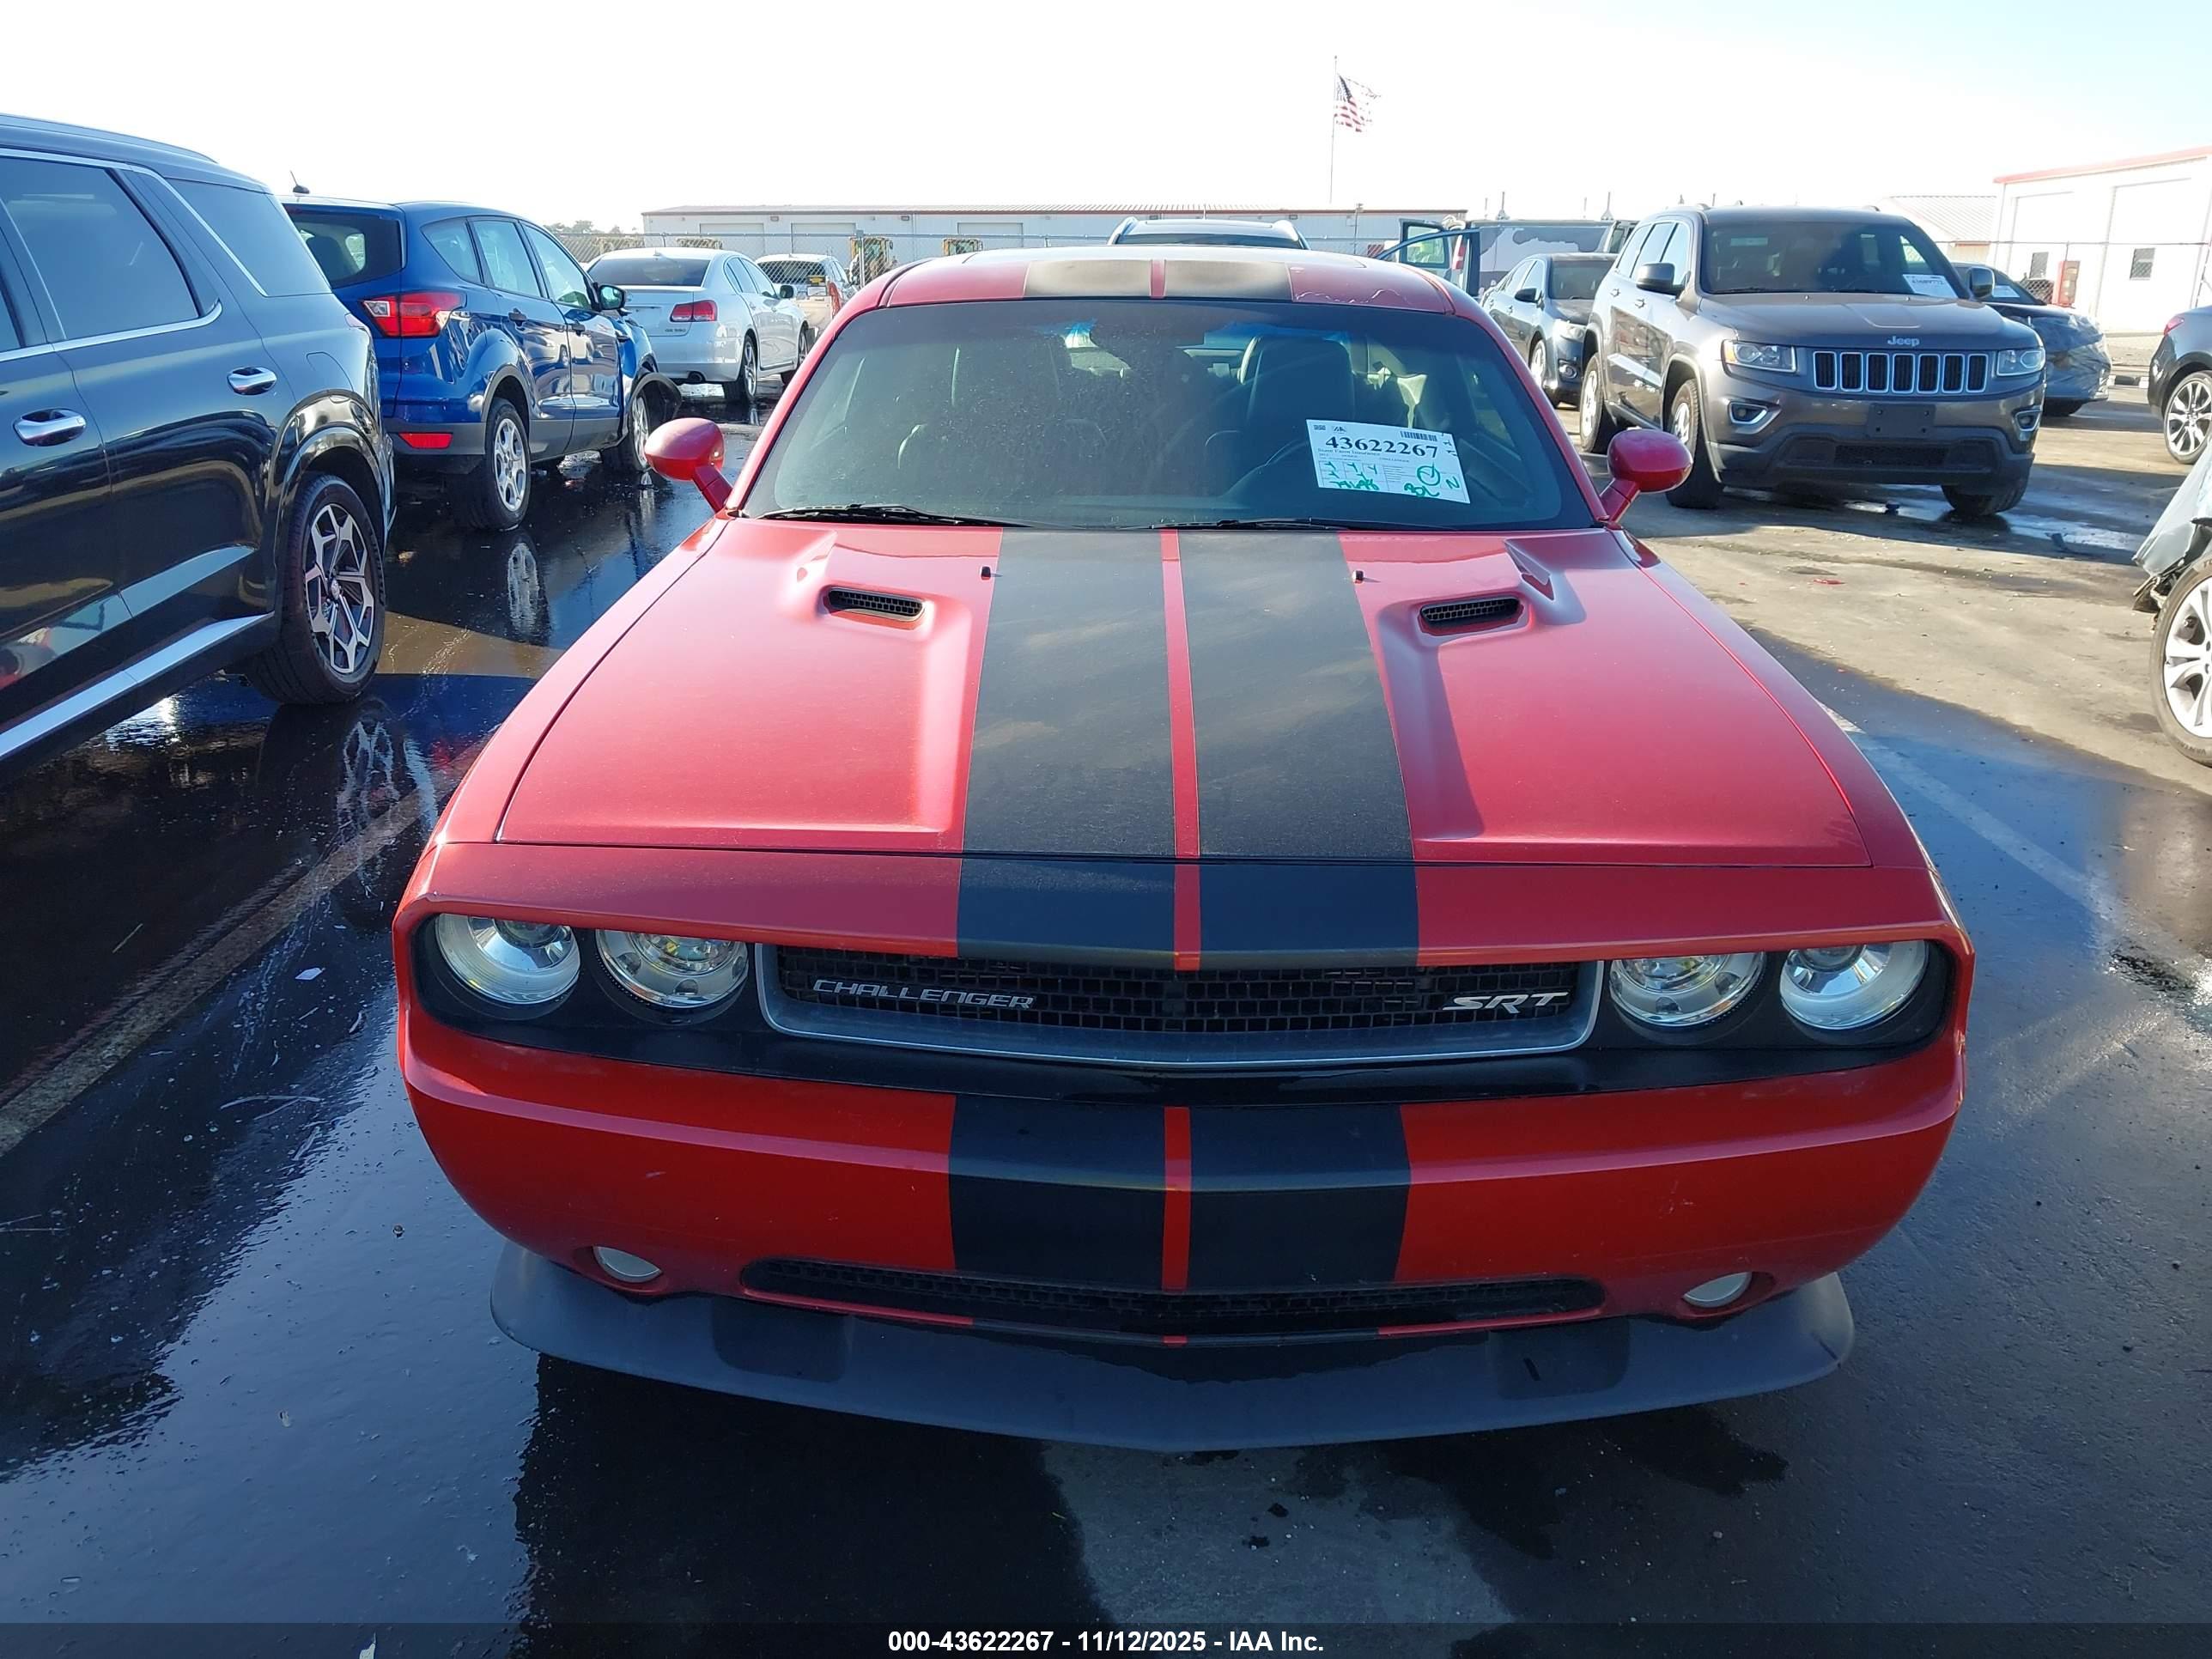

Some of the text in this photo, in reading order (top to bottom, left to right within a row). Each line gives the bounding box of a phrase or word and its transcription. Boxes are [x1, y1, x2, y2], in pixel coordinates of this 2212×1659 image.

[1887, 336, 1920, 347] Jeep
[1325, 435, 1438, 459] 43622267
[812, 979, 1036, 1009] CHALLENGER
[1442, 992, 1569, 1014] SRT
